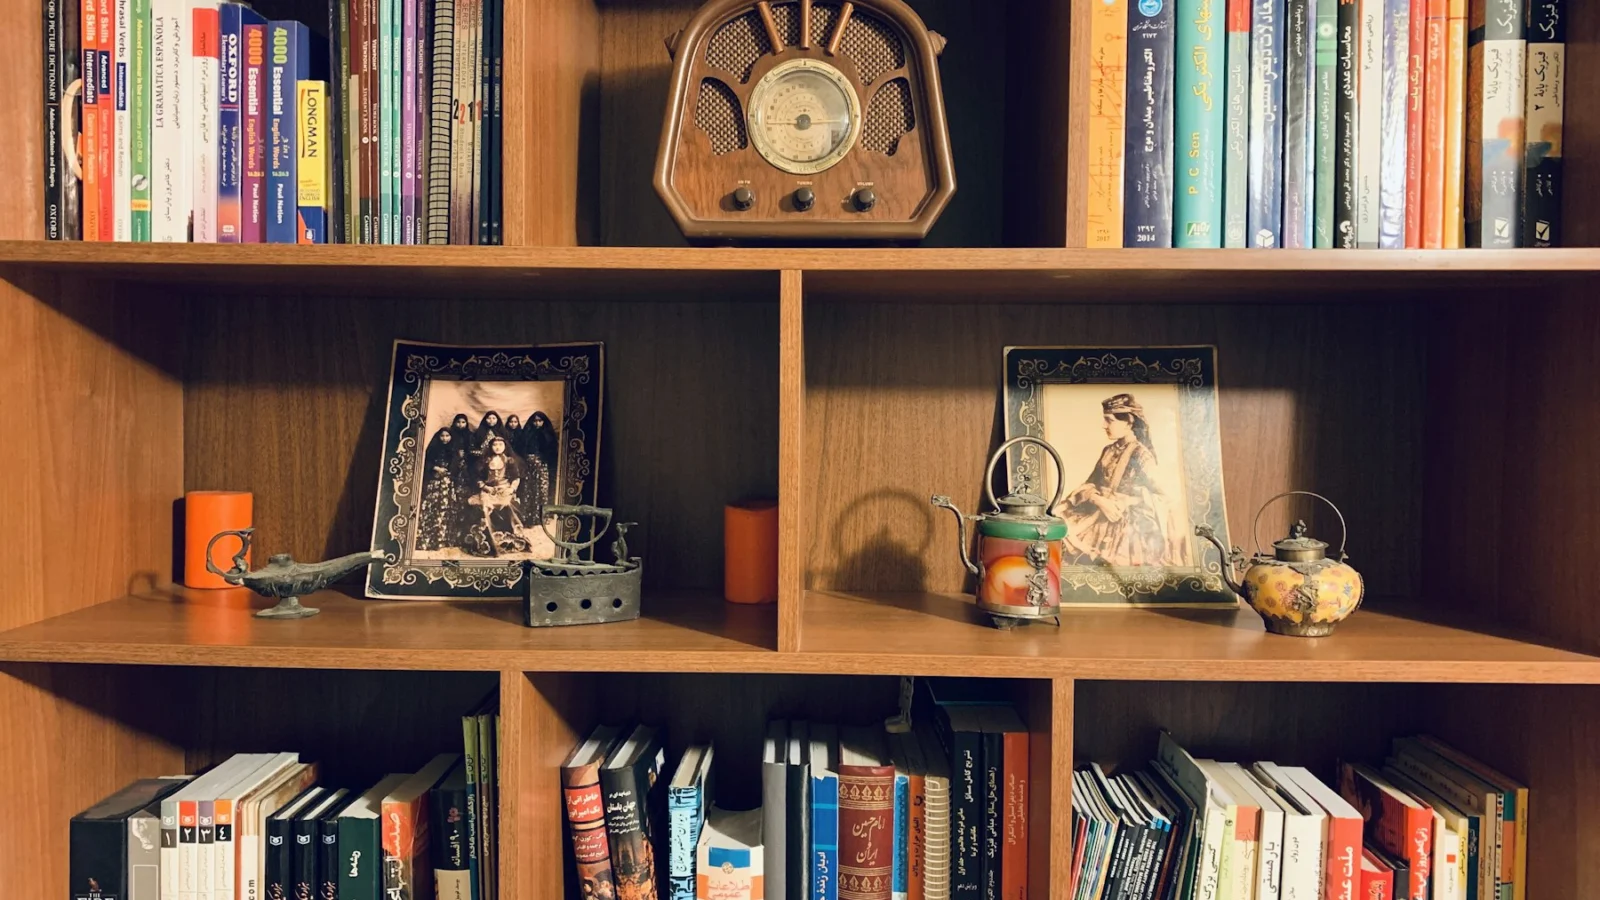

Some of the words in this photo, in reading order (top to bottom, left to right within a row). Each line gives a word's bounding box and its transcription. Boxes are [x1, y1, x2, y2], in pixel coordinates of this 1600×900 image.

[1295, 5, 1303, 32] ریاضیات
[1364, 14, 1374, 37] ریاضی
[1496, 0, 1518, 34] فیزیک
[1538, 4, 1560, 40] فیزیک
[48, 20, 56, 52] PICTURE
[86, 16, 95, 42] Skills
[101, 16, 109, 43] Skills
[136, 19, 144, 48] Advanced
[155, 17, 164, 62] ESPAÑOLA
[171, 17, 180, 42] آموزش
[118, 32, 127, 58] Verbs
[220, 34, 228, 73] Elementary
[248, 28, 263, 65] 4000
[273, 26, 288, 64] 4000
[1295, 33, 1303, 57] مهندسی
[1340, 26, 1353, 70] محاسبات
[1364, 38, 1374, 64] عمومی
[136, 50, 144, 77] Grammar
[229, 33, 237, 103] OXFORD
[1410, 54, 1422, 86] فیزیک
[1488, 48, 1504, 79] فیزیک
[1534, 51, 1548, 82] فیزیک
[48, 53, 56, 101] DICTIONARY
[86, 50, 95, 104] Intermediate
[171, 70, 180, 89] دستور
[220, 74, 228, 102] Learner's
[1142, 48, 1156, 106] الکترومغناطیس
[1193, 46, 1213, 112] الکتریکی
[1232, 64, 1244, 94] ماشین
[1258, 42, 1277, 122] دیفرانسیل
[1340, 71, 1353, 99] عددی
[155, 64, 164, 116] GRAMATICA
[171, 90, 180, 103] زبان
[248, 67, 258, 115] Essential
[272, 66, 283, 115] Essential
[1410, 87, 1422, 112] پایه
[452, 98, 459, 120] 2
[458, 103, 465, 124] 2
[467, 101, 474, 122] 1
[476, 100, 482, 121] 1
[1232, 94, 1244, 116] های
[155, 117, 164, 129] LA
[307, 88, 320, 158] LONGMAN
[1142, 106, 1156, 129] میدان
[247, 118, 256, 145] English
[272, 118, 280, 145] English
[1232, 118, 1244, 160] الکتریکی
[1322, 122, 1330, 140] آماری
[1142, 136, 1156, 152] موج
[1188, 132, 1200, 158] Sen
[164, 158, 172, 172] دکتر
[247, 146, 256, 169] Words
[272, 146, 280, 169] Words
[48, 167, 56, 188] Shapiro
[49, 204, 57, 238] OXFORD
[1136, 234, 1156, 242] 2014
[964, 750, 974, 768] تشریح
[964, 769, 974, 785] کامل
[987, 767, 998, 790] راهنمای
[1008, 774, 1017, 790] حساب
[572, 793, 599, 806] خاطراتی
[964, 785, 974, 803] مسائل
[1008, 791, 1017, 818] دیفرانسیل
[590, 806, 601, 814] یک
[607, 802, 622, 814] باستان
[622, 800, 636, 812] جهان
[987, 800, 998, 818] مسائل
[1018, 803, 1026, 824] تحلیلی
[184, 827, 192, 842] ۲
[200, 828, 211, 842] ۳
[218, 826, 227, 842] ٤
[674, 812, 688, 835] دیوان
[852, 816, 877, 838] حسین
[912, 816, 922, 835] الفبای
[987, 818, 998, 838] مبانی
[1008, 823, 1017, 846] انتگرال
[166, 832, 172, 846] ۱
[468, 833, 476, 858] شاخدار
[912, 836, 922, 853] حرارت
[987, 838, 998, 859] فیزیک
[1138, 828, 1148, 853] WUTHERING
[1263, 842, 1280, 859] بار
[1291, 836, 1299, 849] دون
[384, 836, 408, 870] سال
[448, 843, 461, 866] افسانه
[674, 854, 688, 873] حلاج
[816, 852, 829, 874] ادیان
[856, 848, 879, 866] ایران
[1133, 854, 1141, 871] HEIGHTS
[1145, 850, 1154, 868] GARDEN
[1207, 844, 1219, 874] گتسبی
[1127, 856, 1136, 876] Treasure
[1263, 860, 1280, 894] هستی
[816, 874, 829, 894] زندهٔ
[1133, 871, 1143, 893] MADDING
[1145, 871, 1157, 899] SENSIBILITY
[1203, 876, 1216, 900] بزرگ
